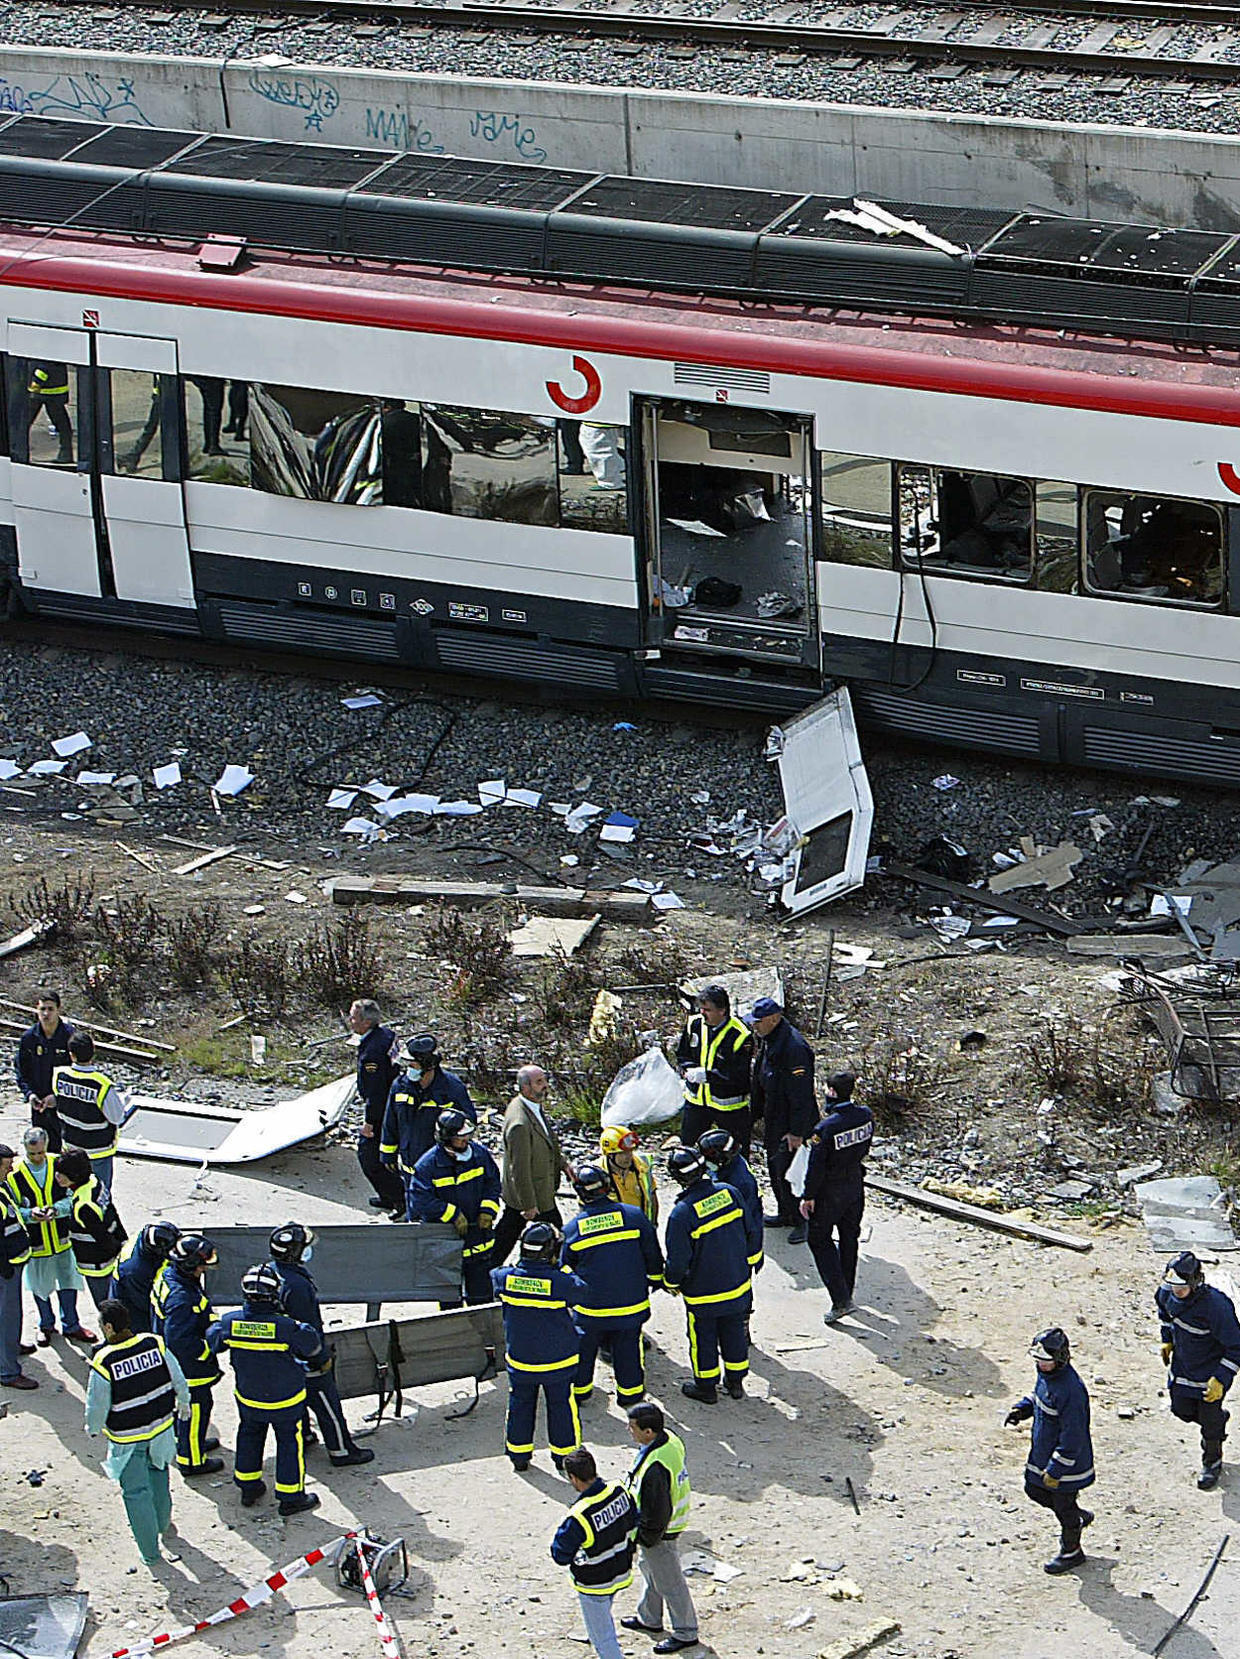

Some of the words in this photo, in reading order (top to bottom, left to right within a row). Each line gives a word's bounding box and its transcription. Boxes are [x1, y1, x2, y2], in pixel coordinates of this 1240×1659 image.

[57, 1080, 98, 1102] POLICIA
[113, 1350, 161, 1379] POLICIA
[593, 1495, 630, 1530] POLICIA
